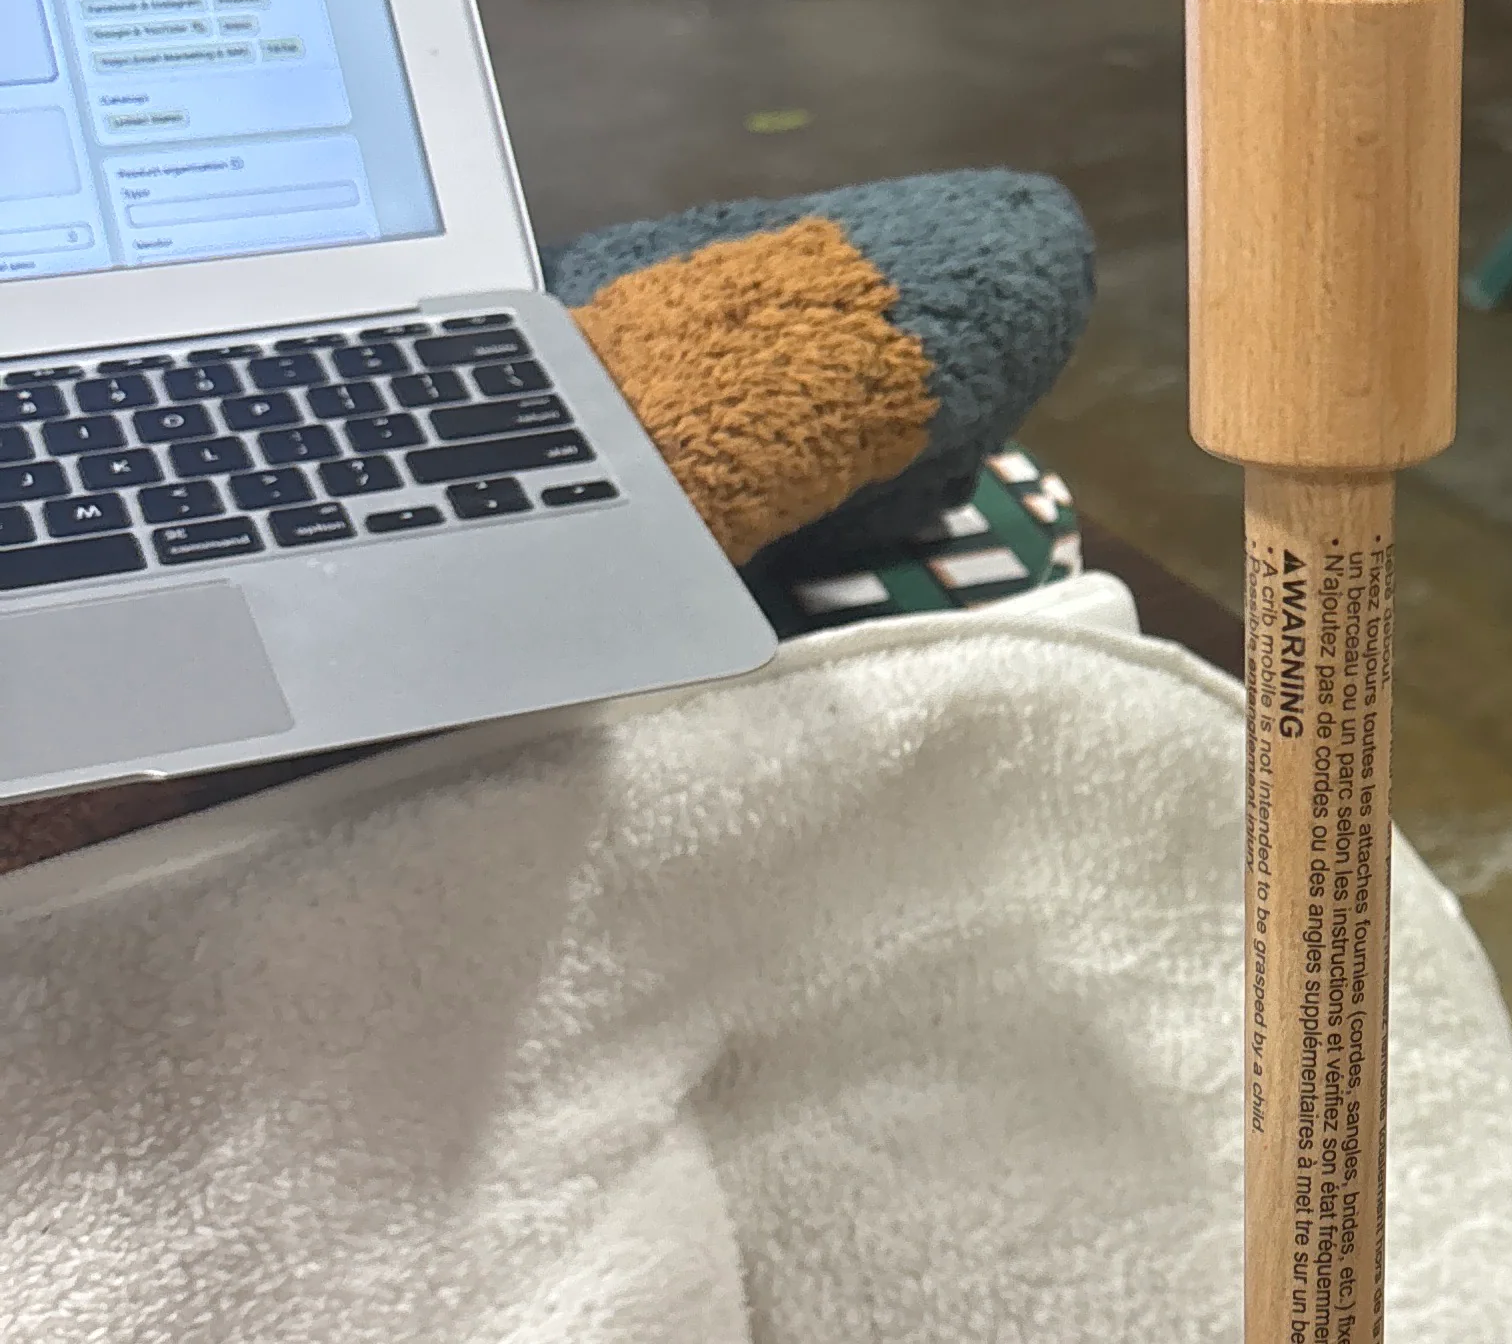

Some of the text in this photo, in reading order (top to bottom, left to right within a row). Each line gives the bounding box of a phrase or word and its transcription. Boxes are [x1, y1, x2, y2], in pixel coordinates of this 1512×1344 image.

[1348, 551, 1363, 580] un
[1366, 550, 1383, 612] Fixez
[1317, 553, 1344, 659] N'ajoutez
[1343, 586, 1365, 678] berceau
[1279, 579, 1307, 739] WARNING
[1314, 665, 1336, 705] pas
[1361, 617, 1380, 707] toujours
[1316, 711, 1336, 740] de
[1341, 683, 1357, 712] ou
[1340, 718, 1356, 746] un
[1360, 712, 1377, 780] toutes
[1312, 745, 1333, 819] cordes
[1335, 752, 1354, 801] parc
[1358, 785, 1375, 817] les
[1250, 559, 1278, 1135] A crib mobile is not intended to be grasped by a child.
[1310, 825, 1328, 852] ou
[1334, 806, 1355, 865] selon
[1308, 858, 1330, 898] des
[1332, 870, 1352, 902] les
[1354, 823, 1372, 914] attaches
[1301, 903, 1326, 974] angles
[1327, 907, 1351, 1027] instructions
[1350, 919, 1370, 1005] fournies
[1298, 979, 1322, 1151] supplémentaires
[1326, 1033, 1344, 1054] et
[1345, 1011, 1367, 1096] (cordes,
[1322, 1057, 1344, 1133] vérifiez
[1296, 1156, 1317, 1169] à
[1320, 1138, 1338, 1176] son
[1340, 1100, 1361, 1187] sangles,
[1318, 1181, 1339, 1220] état
[1337, 1191, 1359, 1263] brides,
[1291, 1251, 1309, 1285] sur
[1333, 1266, 1355, 1311] etc.)
[1290, 1289, 1307, 1315] un
